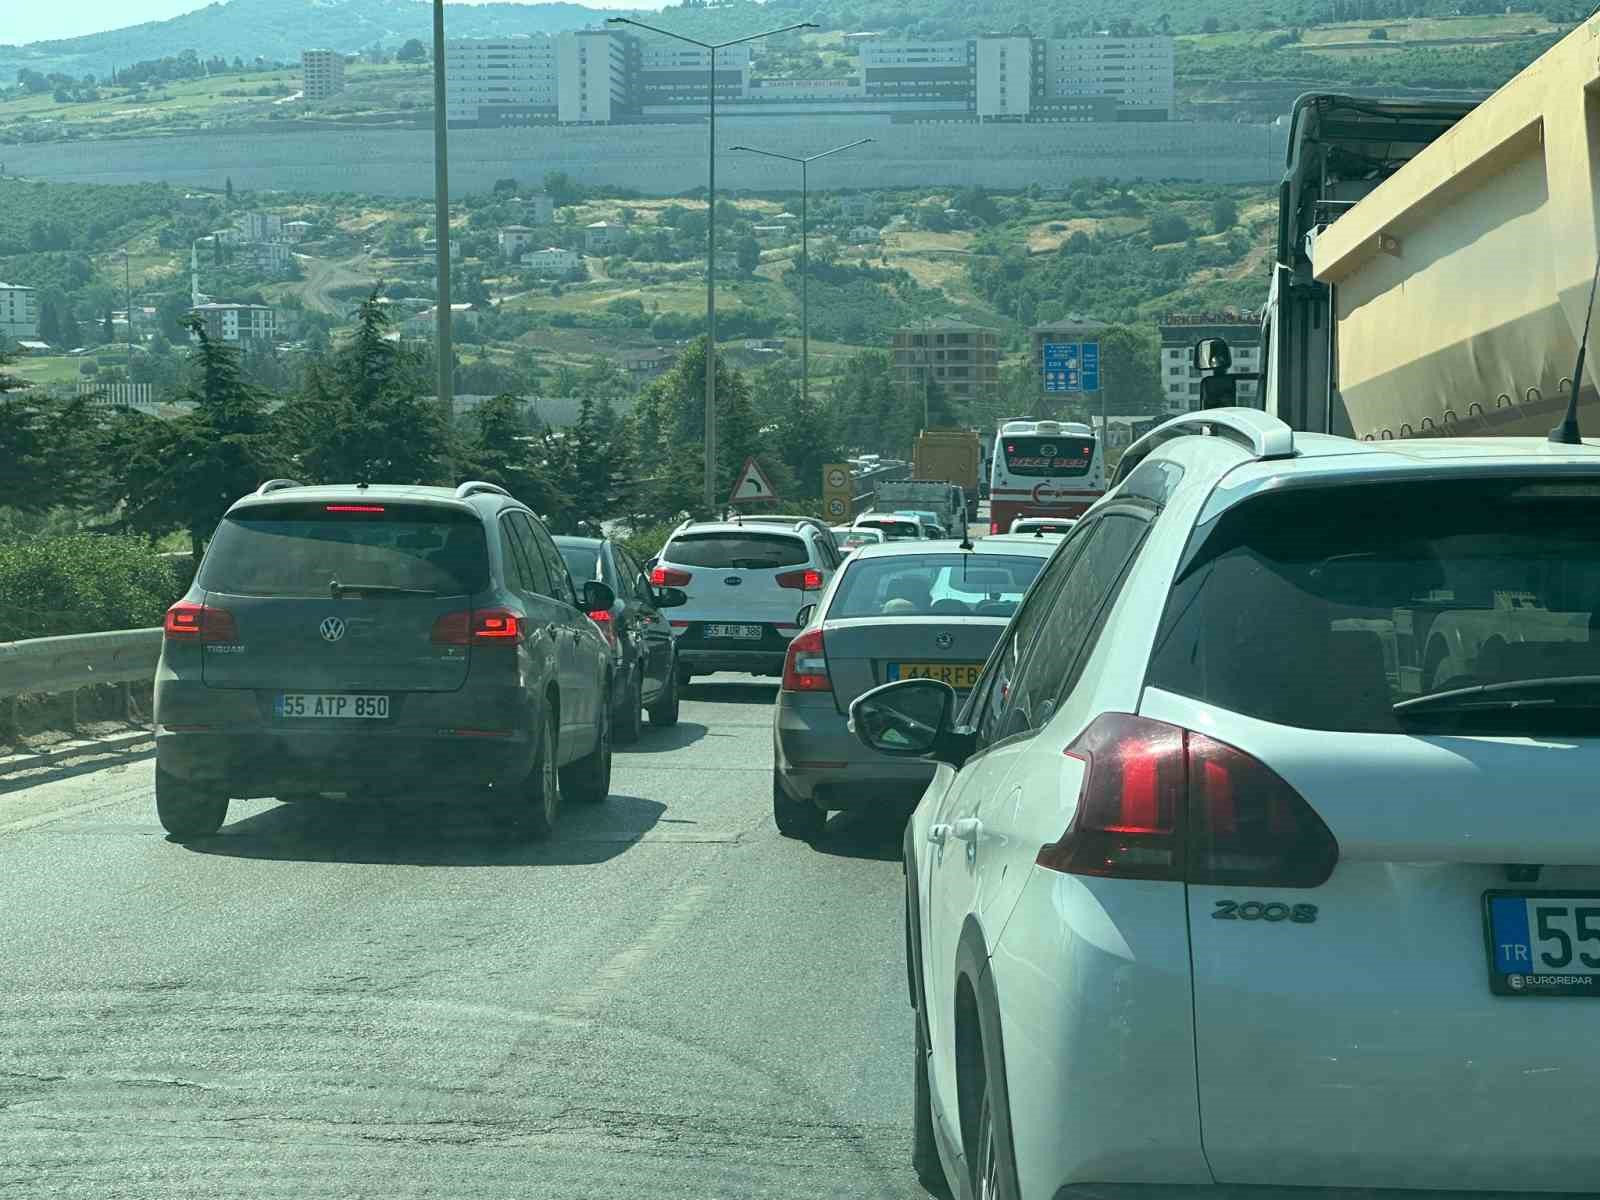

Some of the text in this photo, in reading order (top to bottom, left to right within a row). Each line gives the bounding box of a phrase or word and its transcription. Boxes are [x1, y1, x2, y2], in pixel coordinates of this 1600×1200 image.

[283, 695, 388, 716] 55 ATP 850
[1211, 900, 1319, 924] 2008
[1535, 906, 1600, 969] 55
[1501, 943, 1529, 962] TR
[1526, 975, 1593, 986] EUROREPAR
